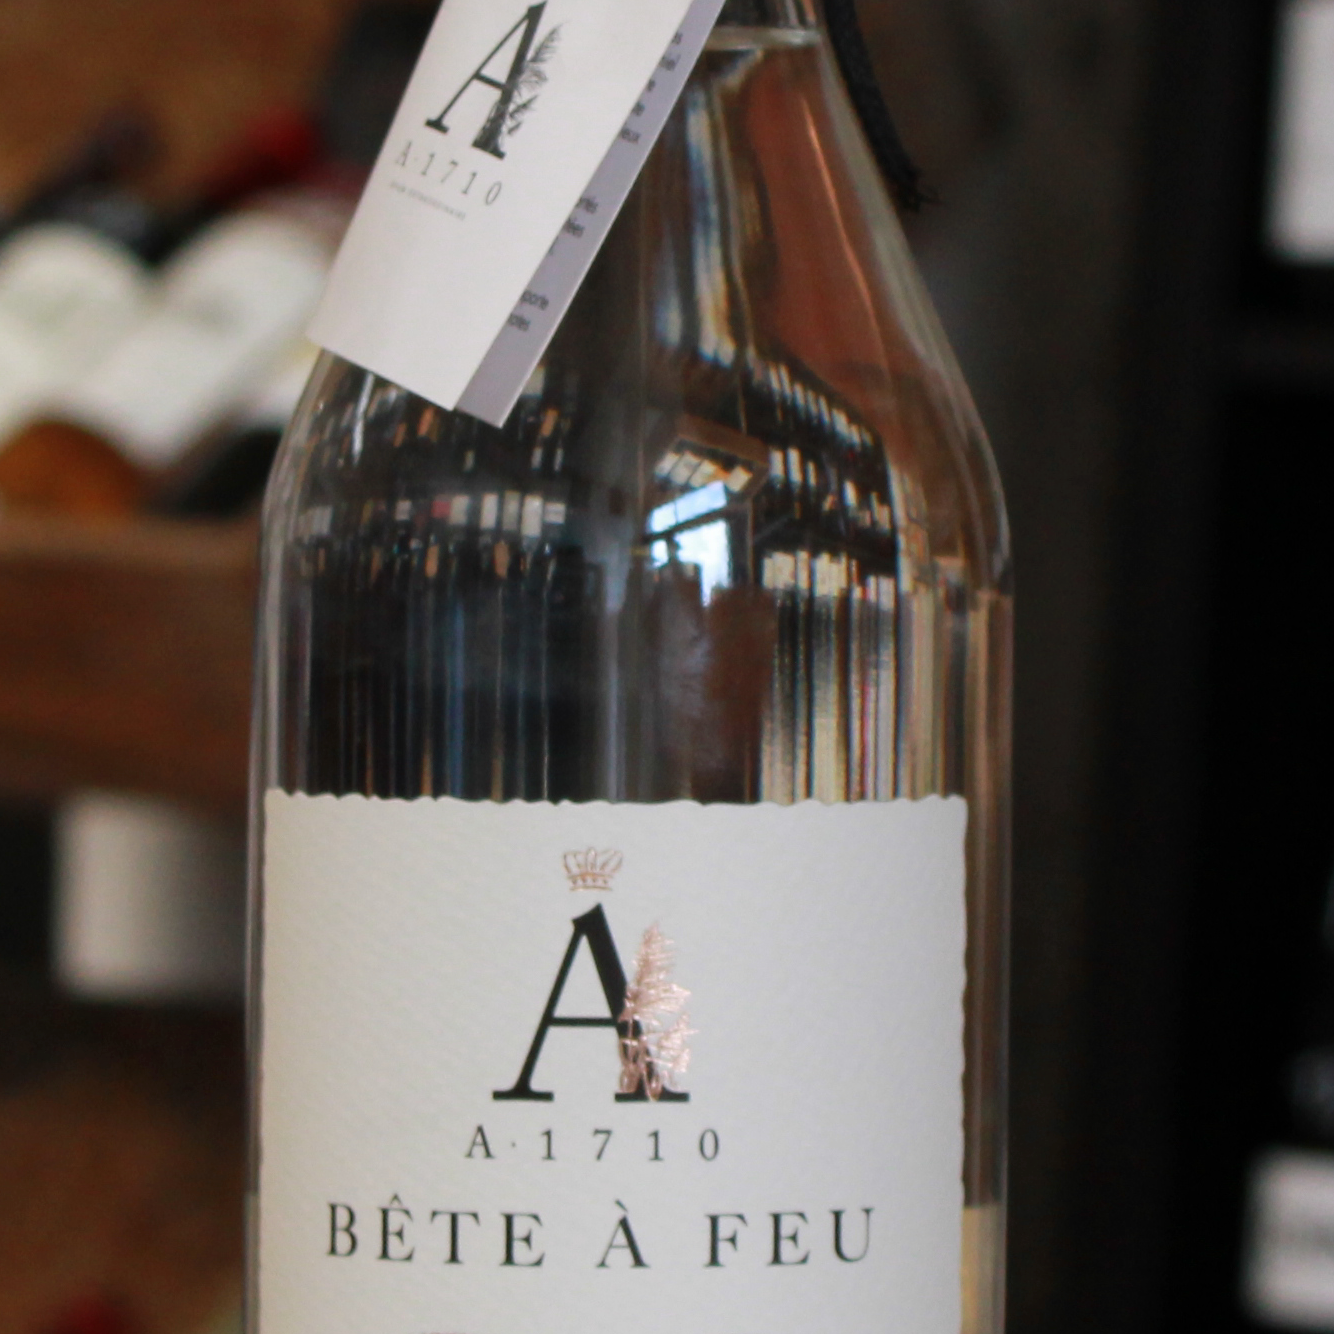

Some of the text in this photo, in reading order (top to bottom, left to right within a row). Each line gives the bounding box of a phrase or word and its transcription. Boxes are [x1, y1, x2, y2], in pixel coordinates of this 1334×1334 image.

[425, 0, 548, 160] A
[491, 902, 692, 1104] A
[325, 1192, 875, 1270] BÊTE À FEU
